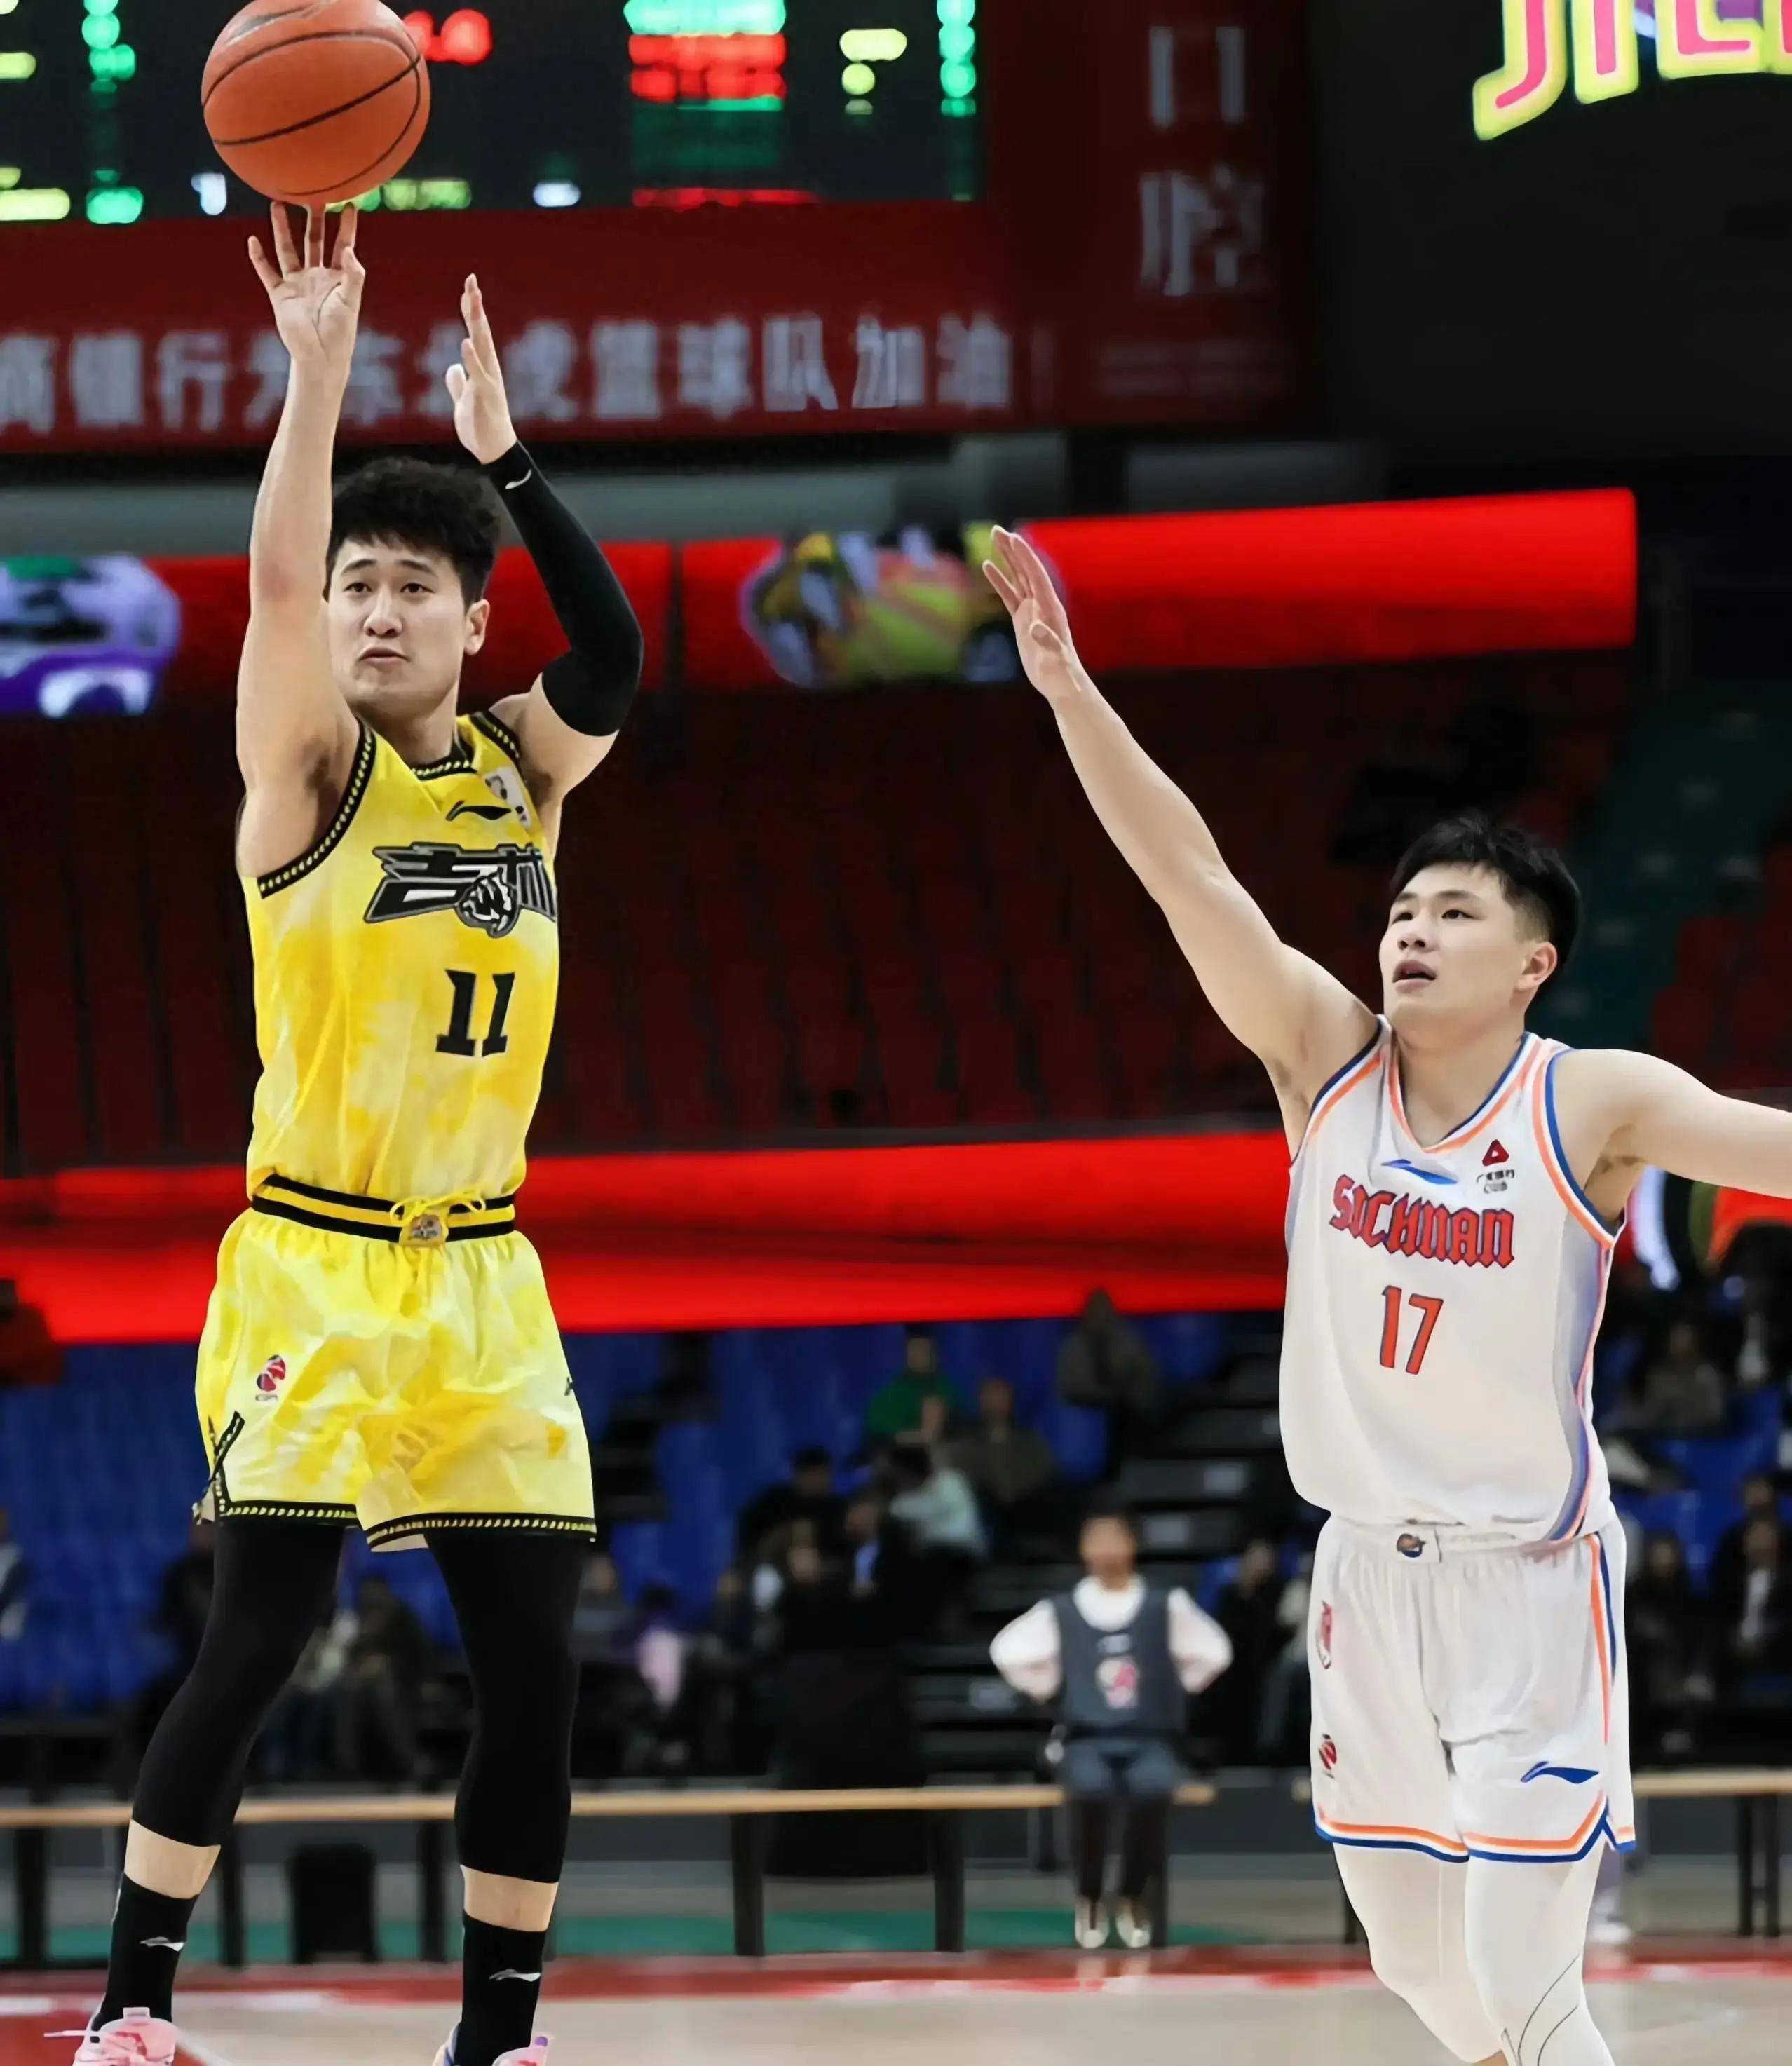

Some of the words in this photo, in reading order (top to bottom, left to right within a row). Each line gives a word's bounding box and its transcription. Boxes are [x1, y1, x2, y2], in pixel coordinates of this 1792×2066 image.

[435, 969, 515, 1058] 11
[1330, 1174, 1515, 1269] SICHUAN
[1380, 1284, 1444, 1375] 17
